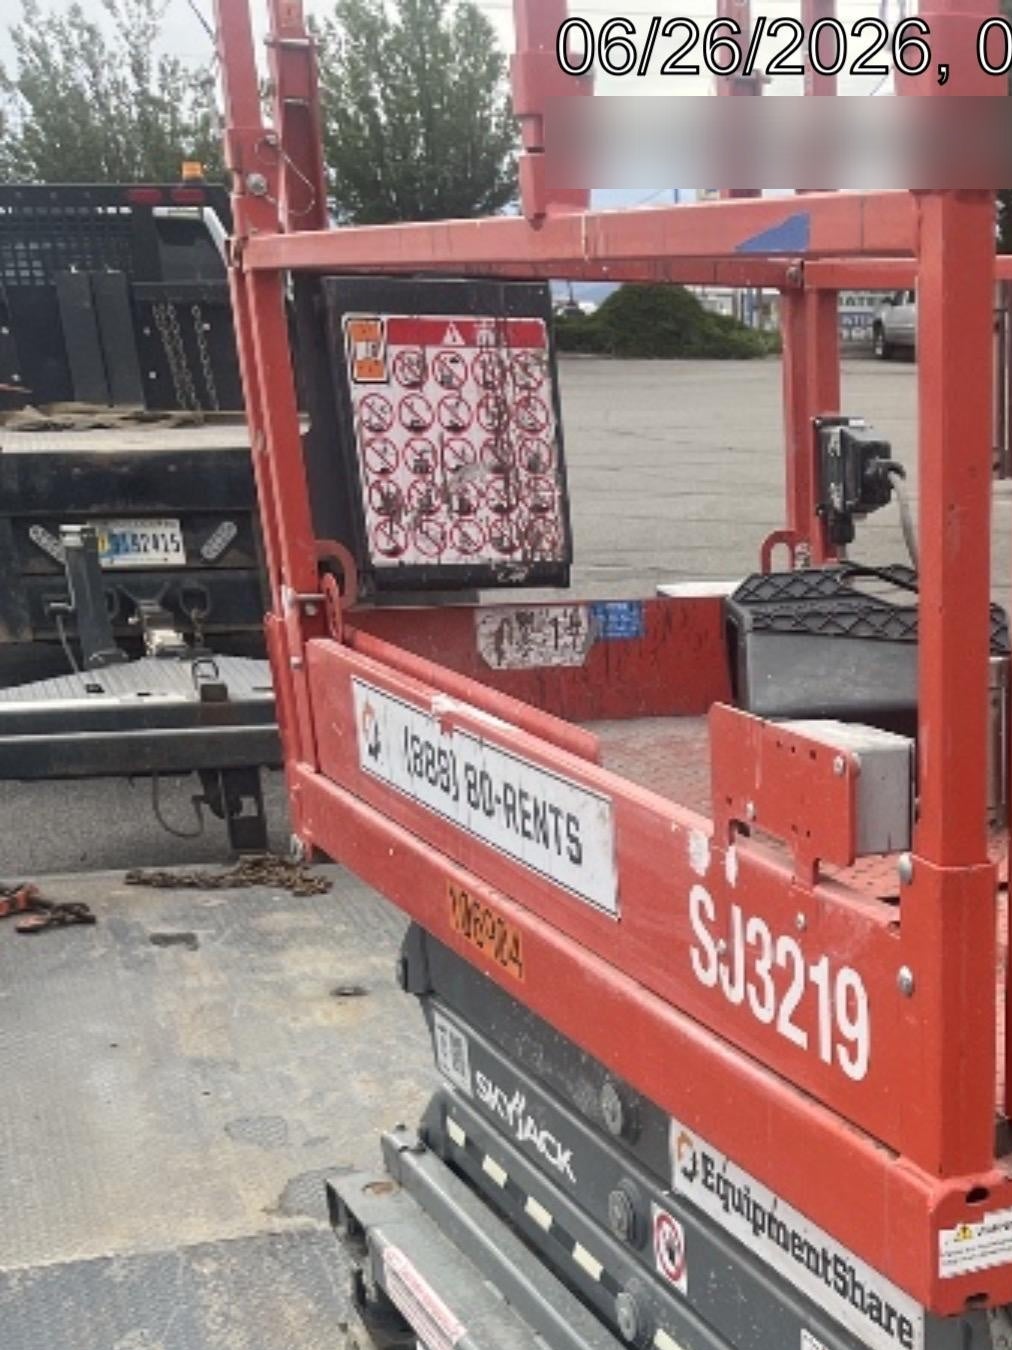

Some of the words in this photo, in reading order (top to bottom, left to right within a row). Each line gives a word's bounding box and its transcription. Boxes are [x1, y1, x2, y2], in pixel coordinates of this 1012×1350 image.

[464, 762, 583, 866] 80-RENTS
[688, 884, 871, 1081] SJ3219
[701, 1150, 914, 1350] EquipmentShare
